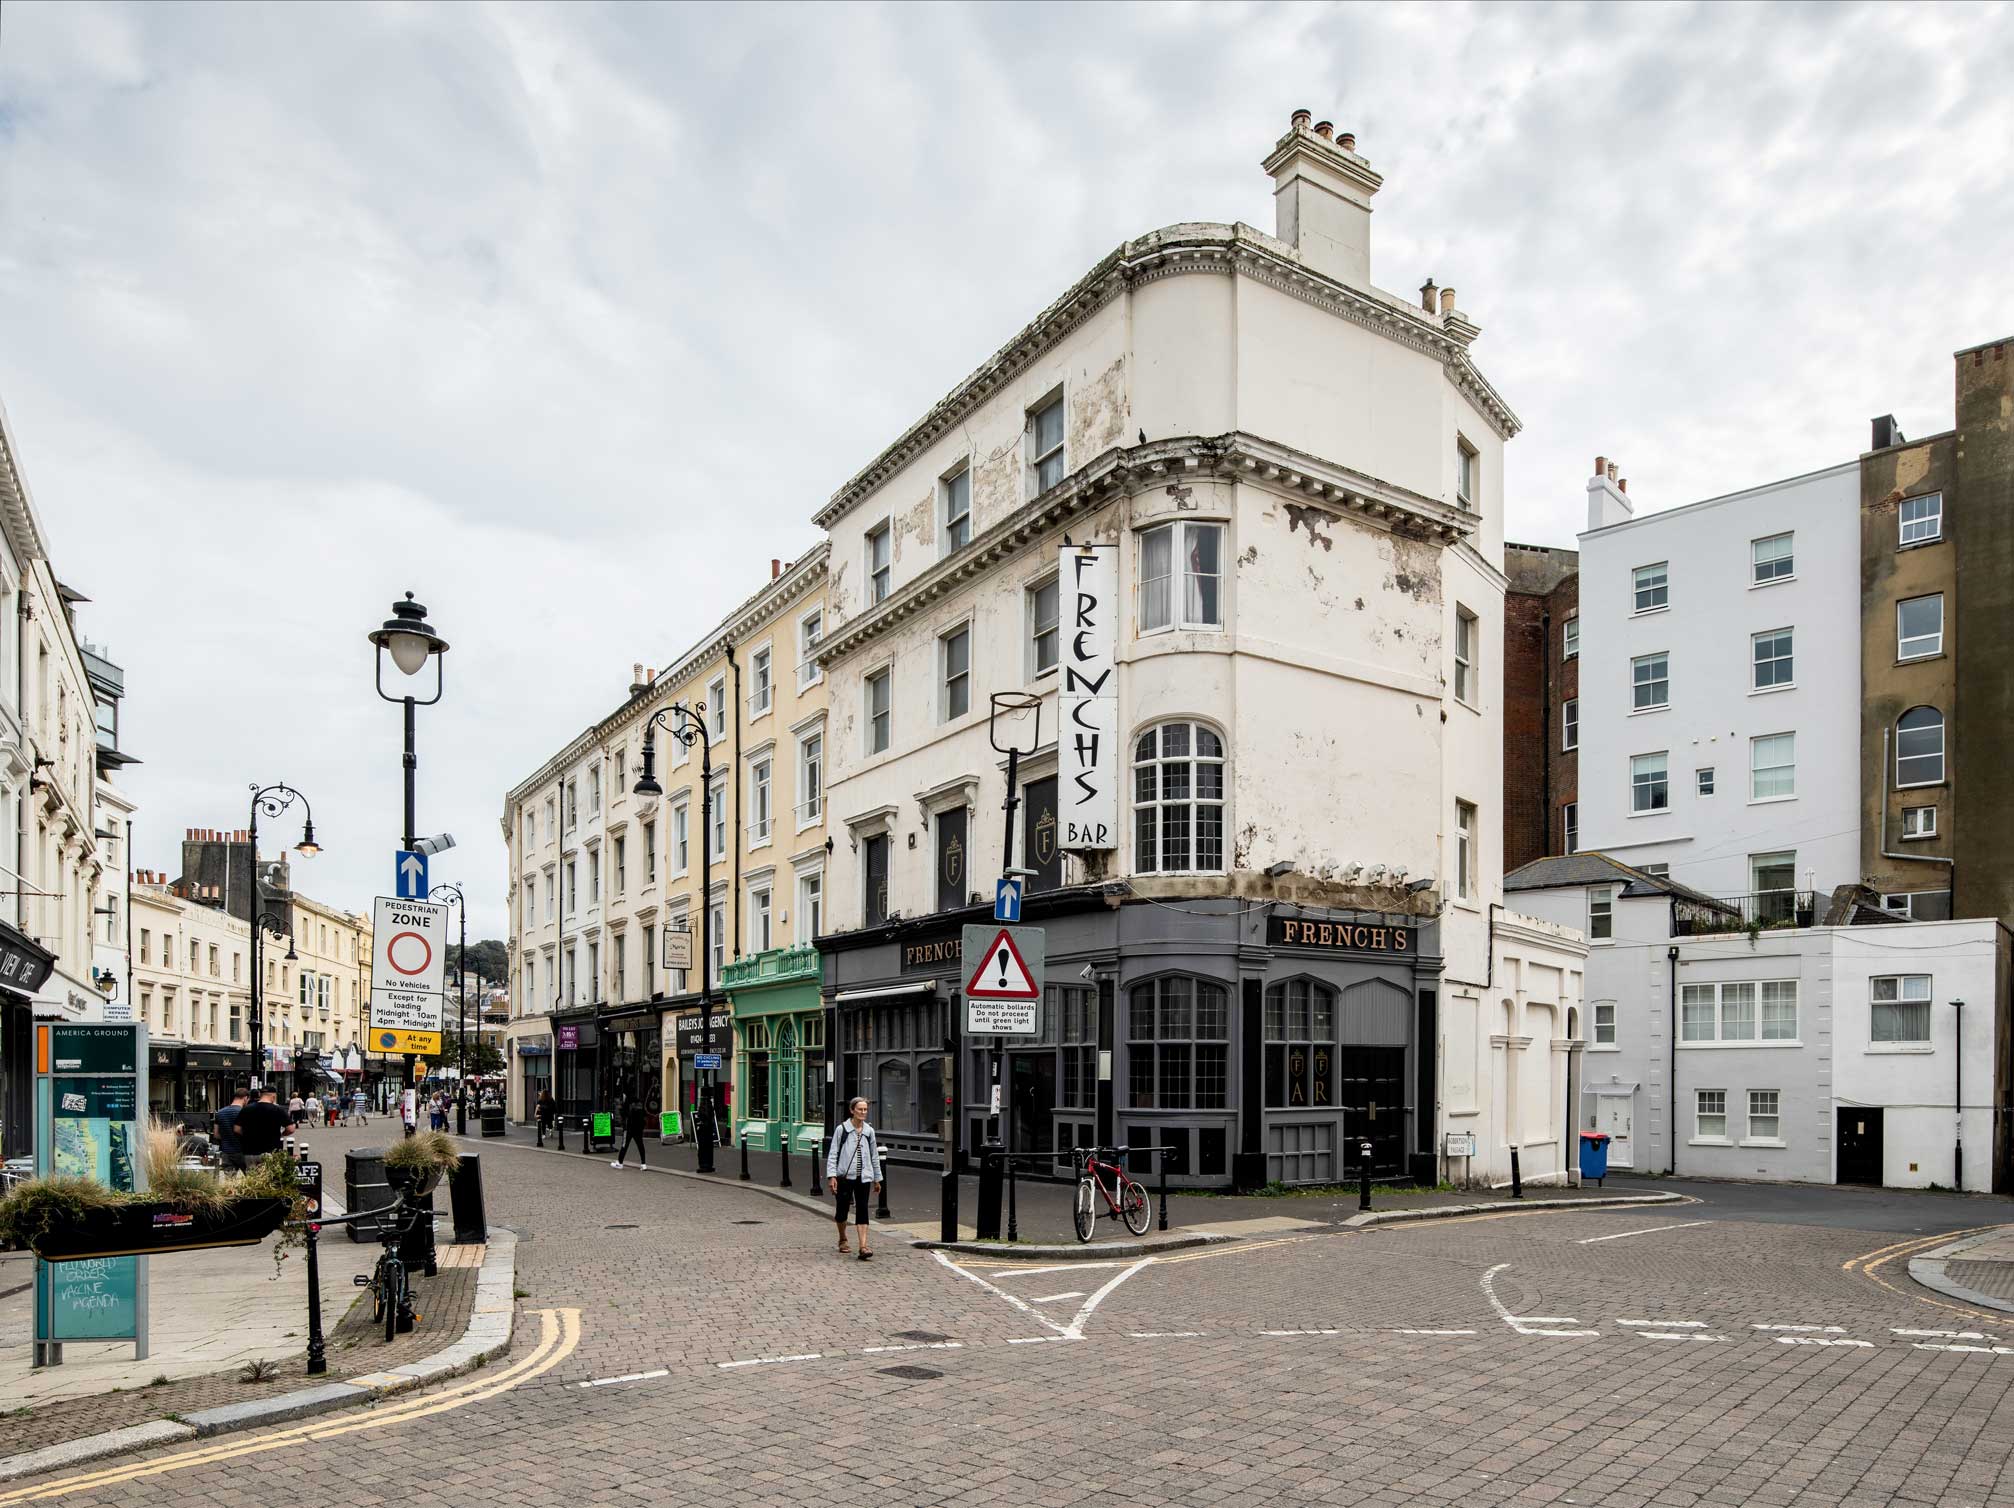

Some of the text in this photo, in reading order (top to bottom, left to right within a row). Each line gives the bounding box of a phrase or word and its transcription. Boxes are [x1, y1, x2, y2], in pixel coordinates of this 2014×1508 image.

[1066, 555, 1111, 806] FRENCHS
[1068, 822, 1108, 844] BAR
[385, 901, 438, 914] PEDESTRIAN
[392, 913, 431, 927] ZONE
[1283, 920, 1407, 950] FRENCH'S
[906, 940, 962, 965] FRENCH
[400, 981, 430, 989] Vehicles
[388, 993, 414, 1002] Except
[376, 1008, 410, 1018] Midnight
[394, 1002, 421, 1011] loading
[377, 1017, 435, 1029] 4pm Midnight
[679, 1018, 697, 1031] BAILEYS
[291, 1165, 319, 1177] AFE
[66, 1267, 110, 1282] ORDER
[61, 1281, 104, 1301] VACCINE
[73, 1292, 120, 1311] AGENDA
